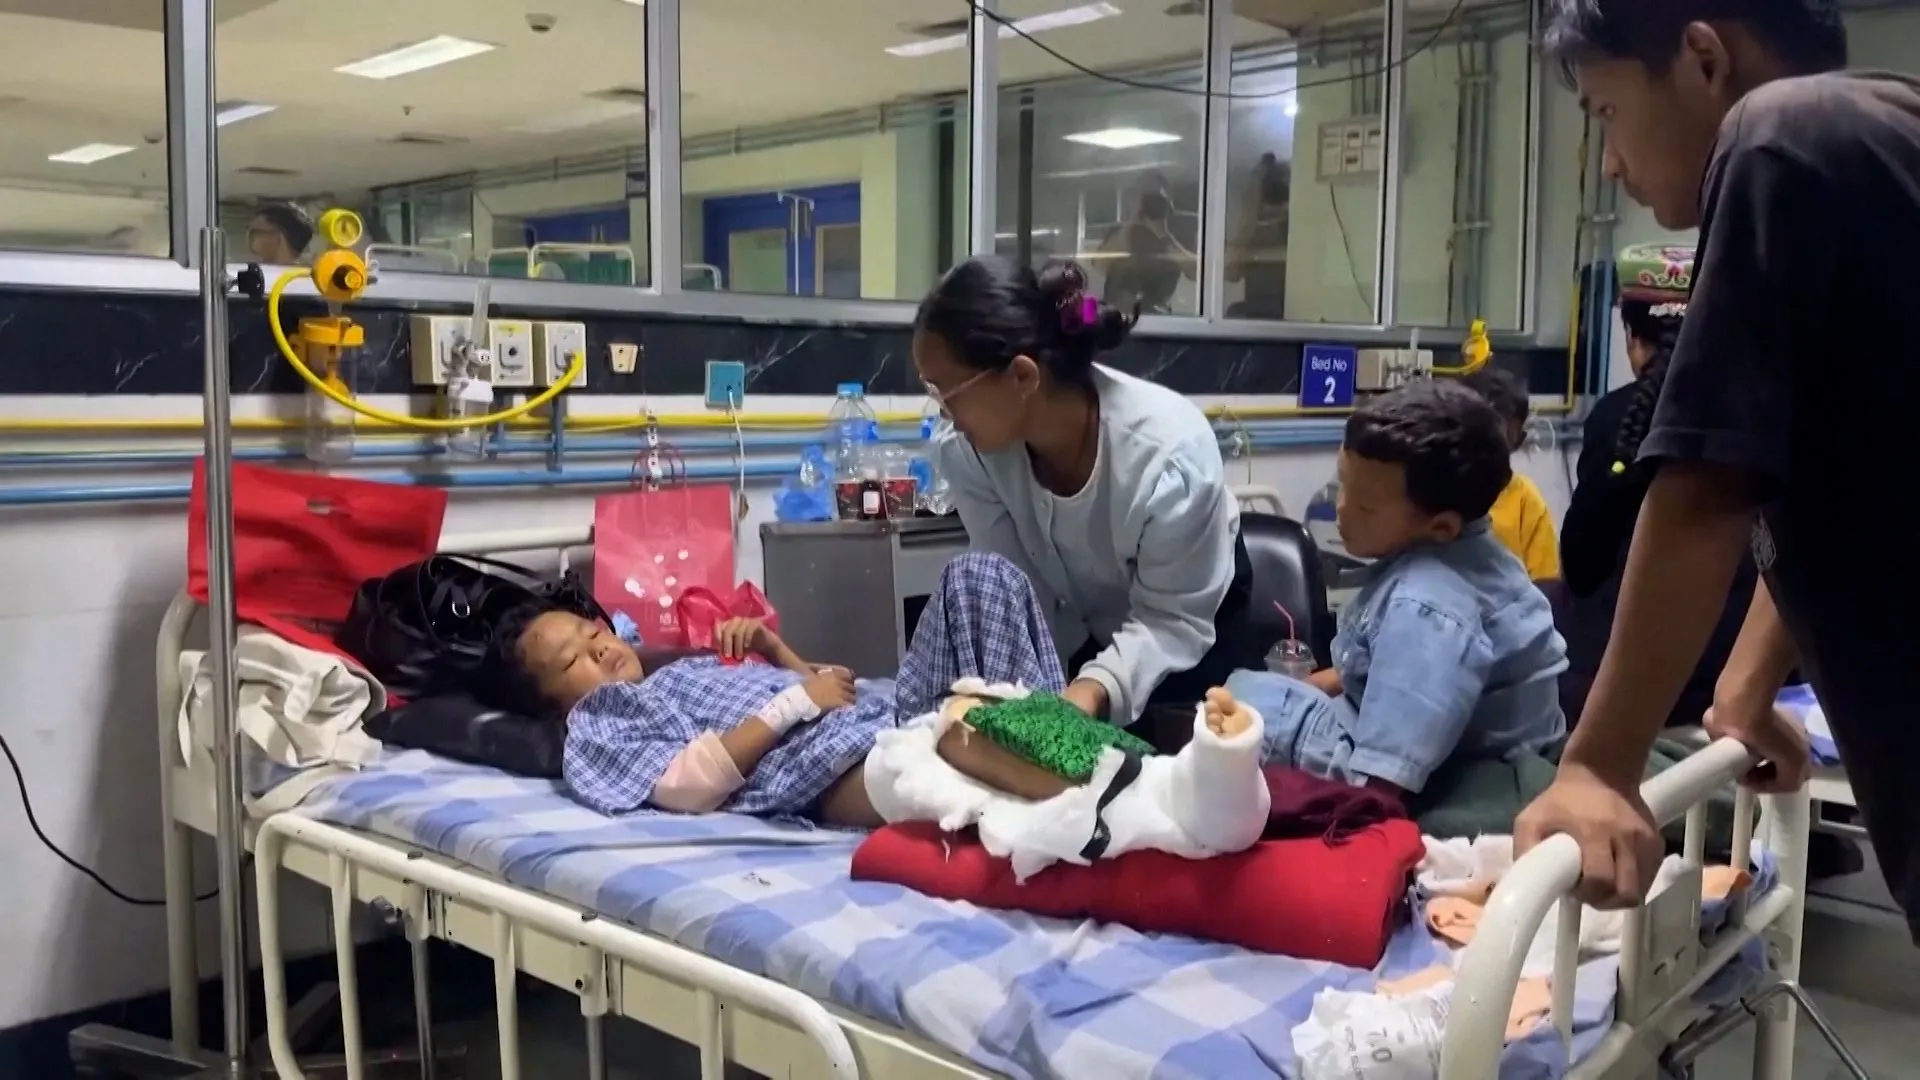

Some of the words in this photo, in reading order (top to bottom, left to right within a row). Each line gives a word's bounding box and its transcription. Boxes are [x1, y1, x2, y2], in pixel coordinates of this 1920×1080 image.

[1311, 355, 1330, 371] Bed
[1332, 357, 1348, 372] No
[1323, 375, 1337, 404] 2
